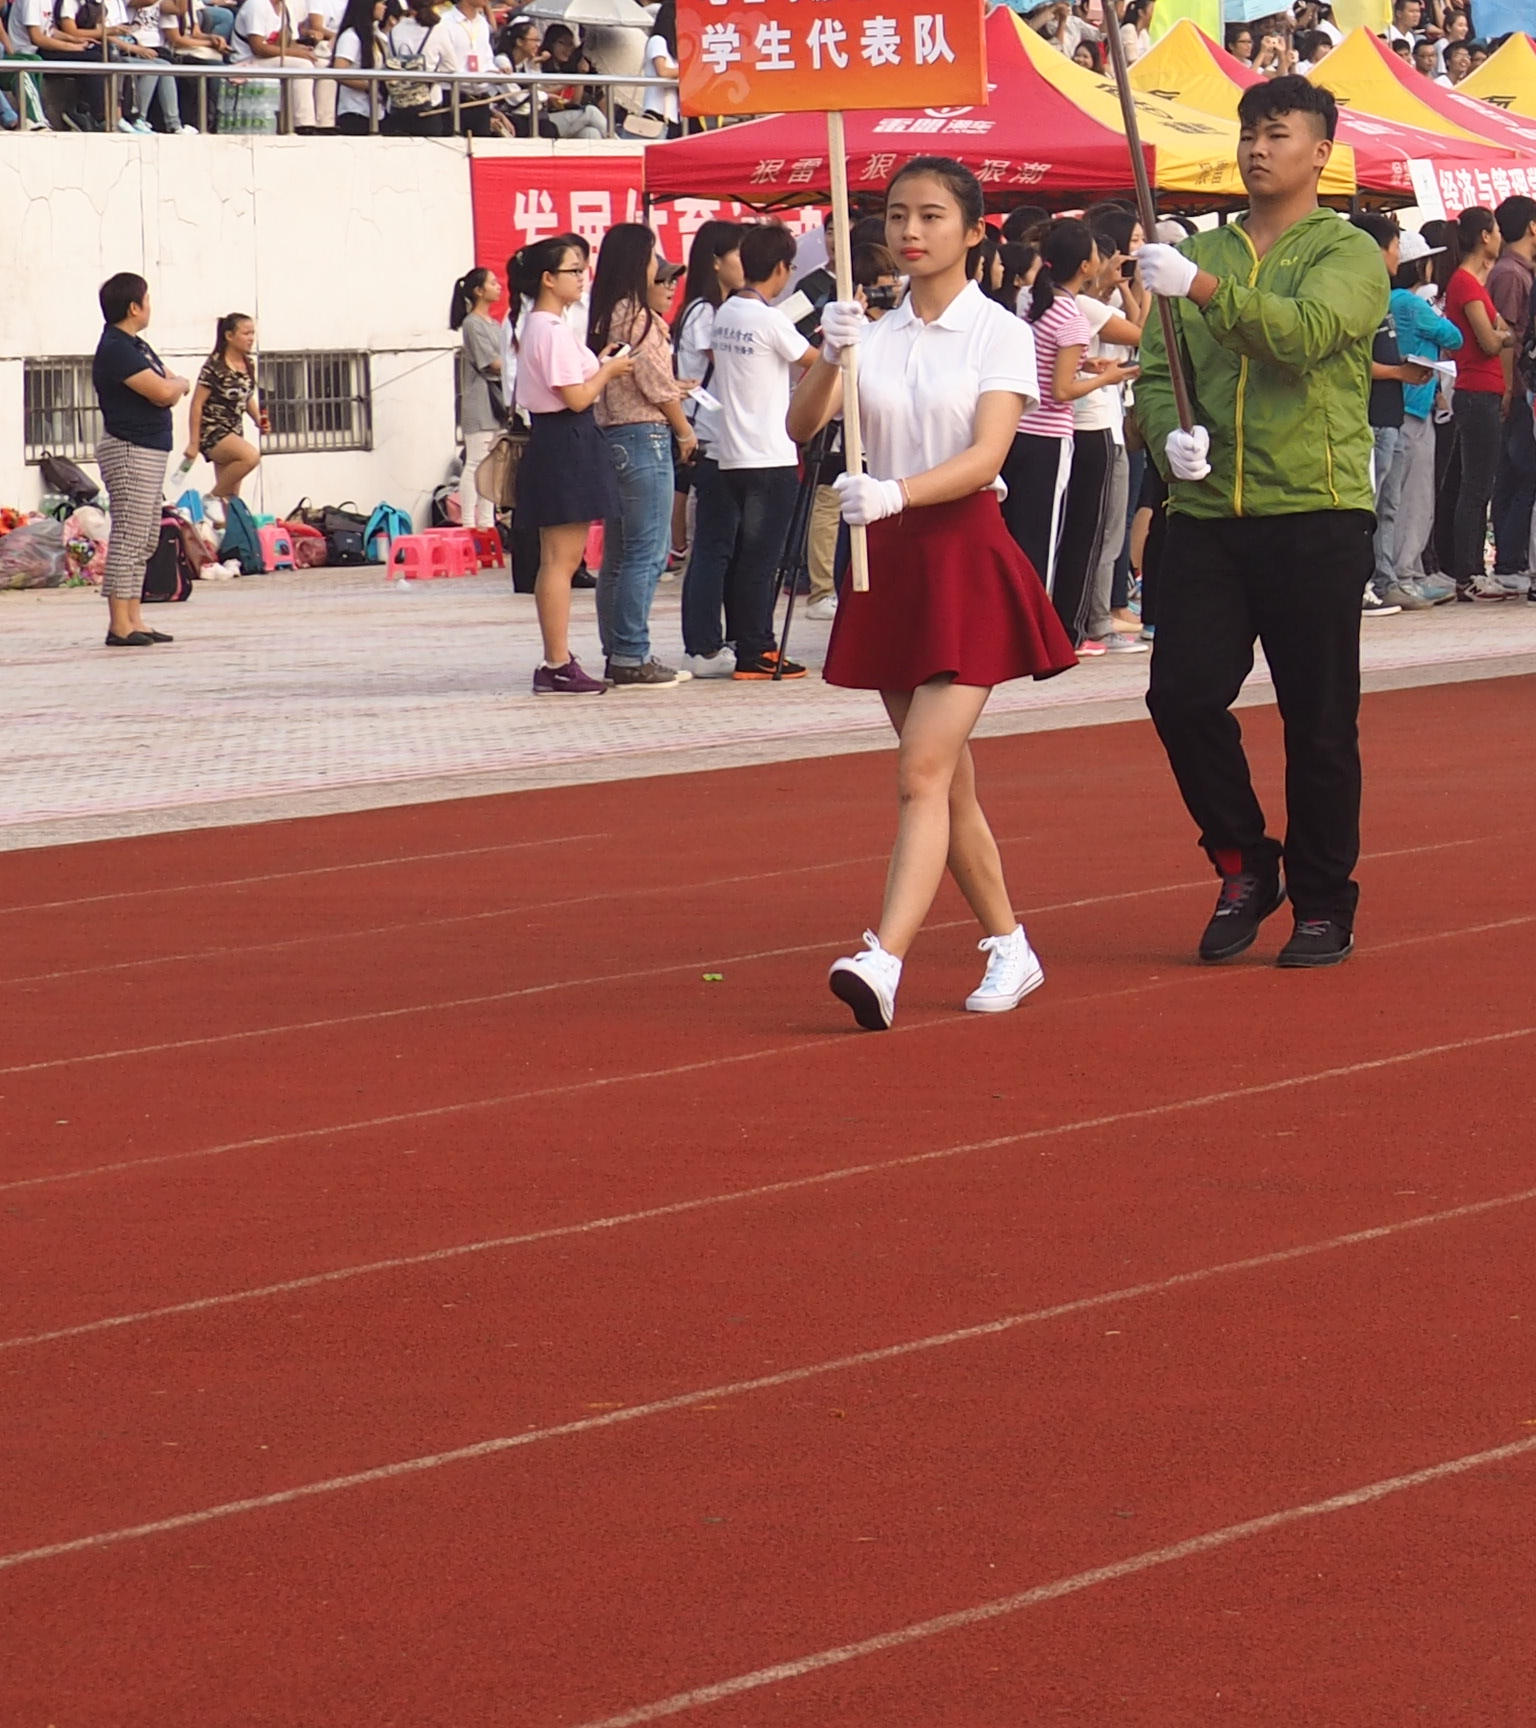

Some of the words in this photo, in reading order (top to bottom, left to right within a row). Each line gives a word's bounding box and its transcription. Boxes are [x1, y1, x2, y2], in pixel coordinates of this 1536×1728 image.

[701, 14, 956, 74] 学生代表队
